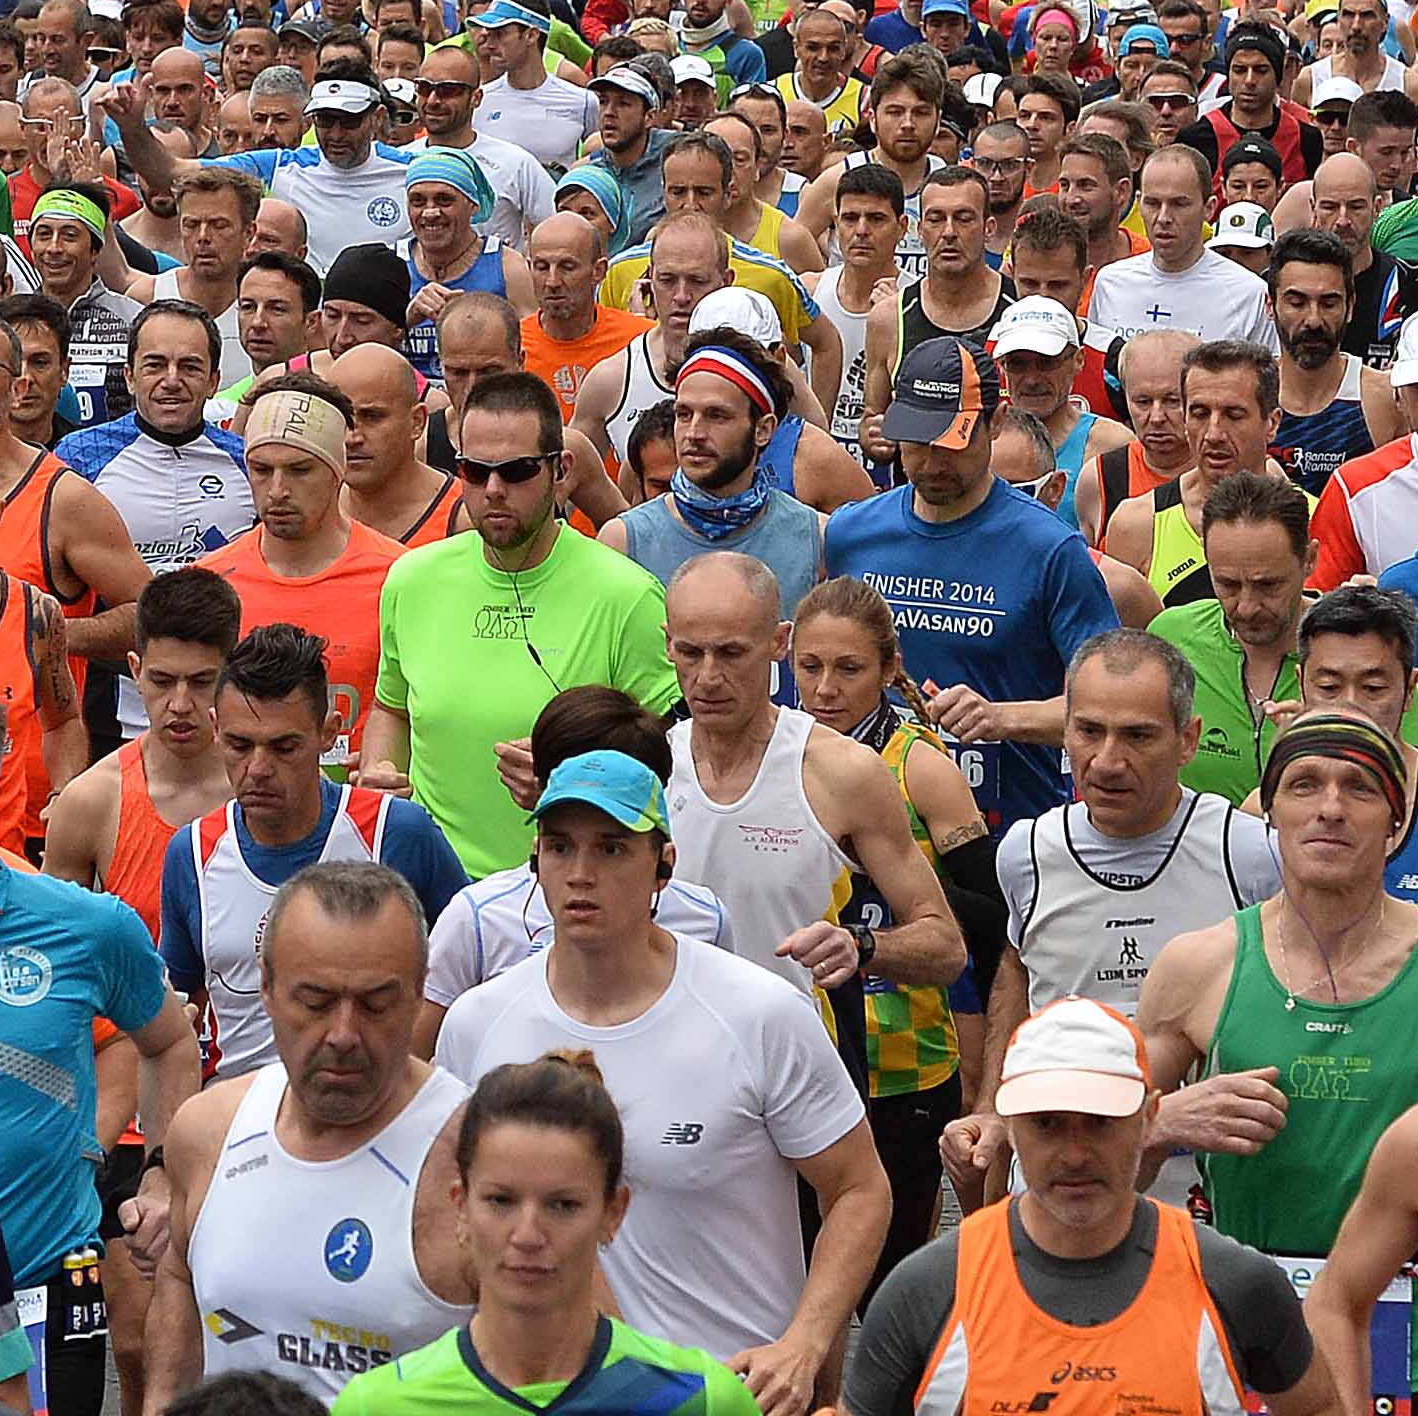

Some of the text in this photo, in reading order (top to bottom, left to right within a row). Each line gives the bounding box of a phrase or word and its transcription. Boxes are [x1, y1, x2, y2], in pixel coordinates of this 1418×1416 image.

[1303, 462, 1338, 475] Roma
[863, 572, 997, 606] FINISHER 2014
[891, 604, 993, 638] AVASAN90
[1306, 1022, 1340, 1034] CRAFT
[660, 1121, 705, 1146] NB
[309, 1319, 391, 1353] TECNO
[1072, 1365, 1117, 1382] asics
